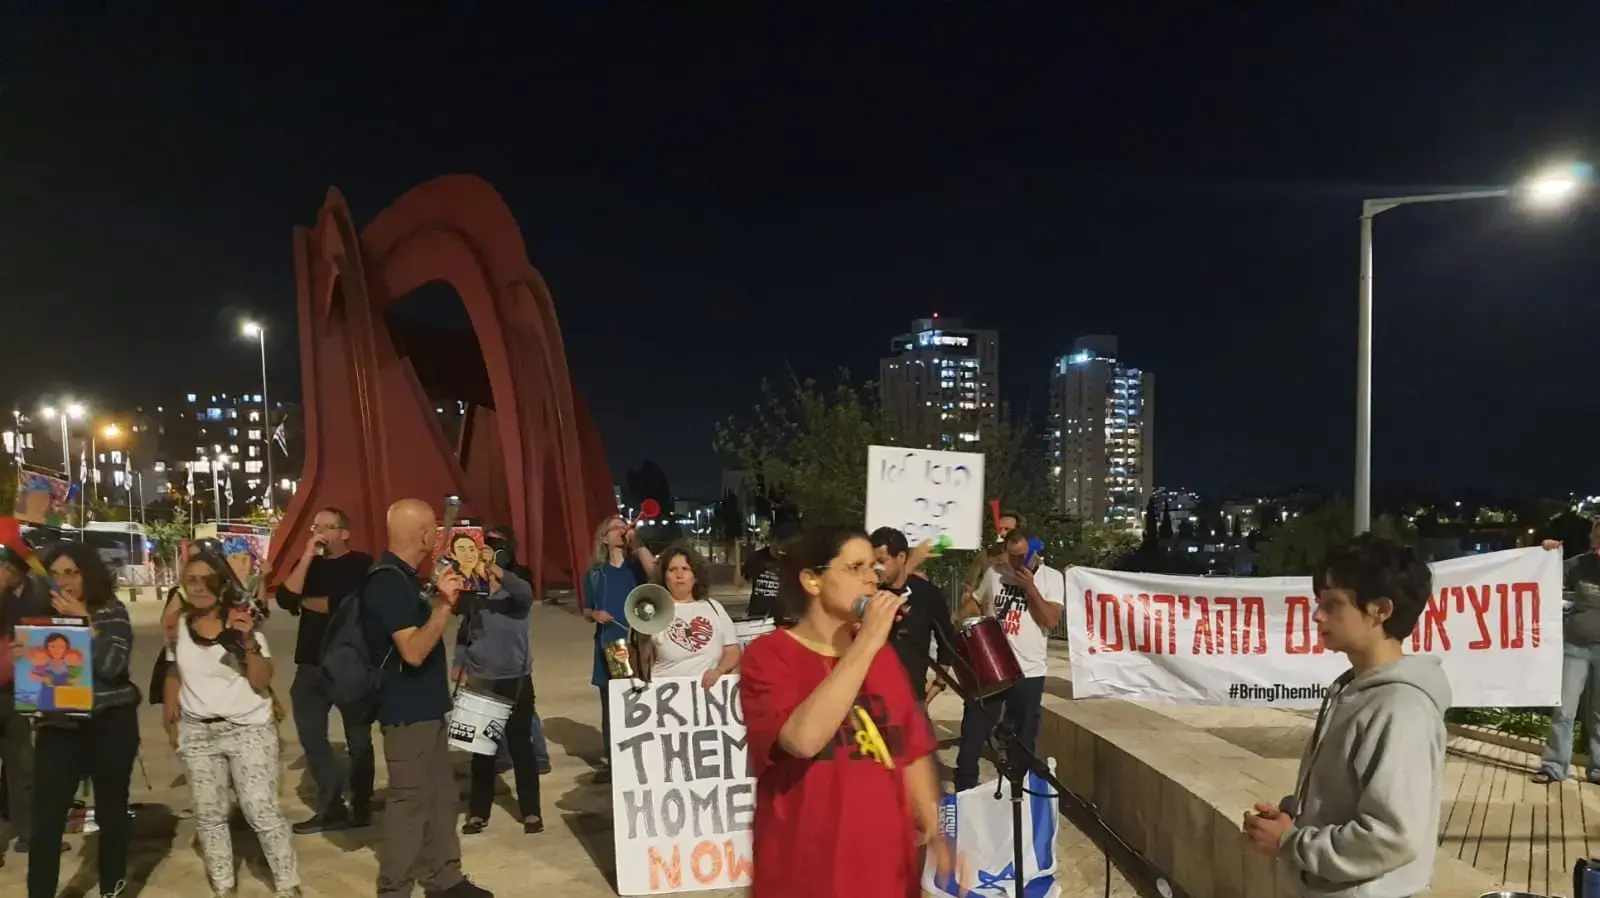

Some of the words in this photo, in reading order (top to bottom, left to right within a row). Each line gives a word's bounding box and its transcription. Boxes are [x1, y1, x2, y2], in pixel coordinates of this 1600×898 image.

[1084, 588, 1267, 655] מהגיהנום!
[616, 729, 752, 785] THEM
[622, 784, 754, 839] HOME
[648, 839, 753, 890] NOW
